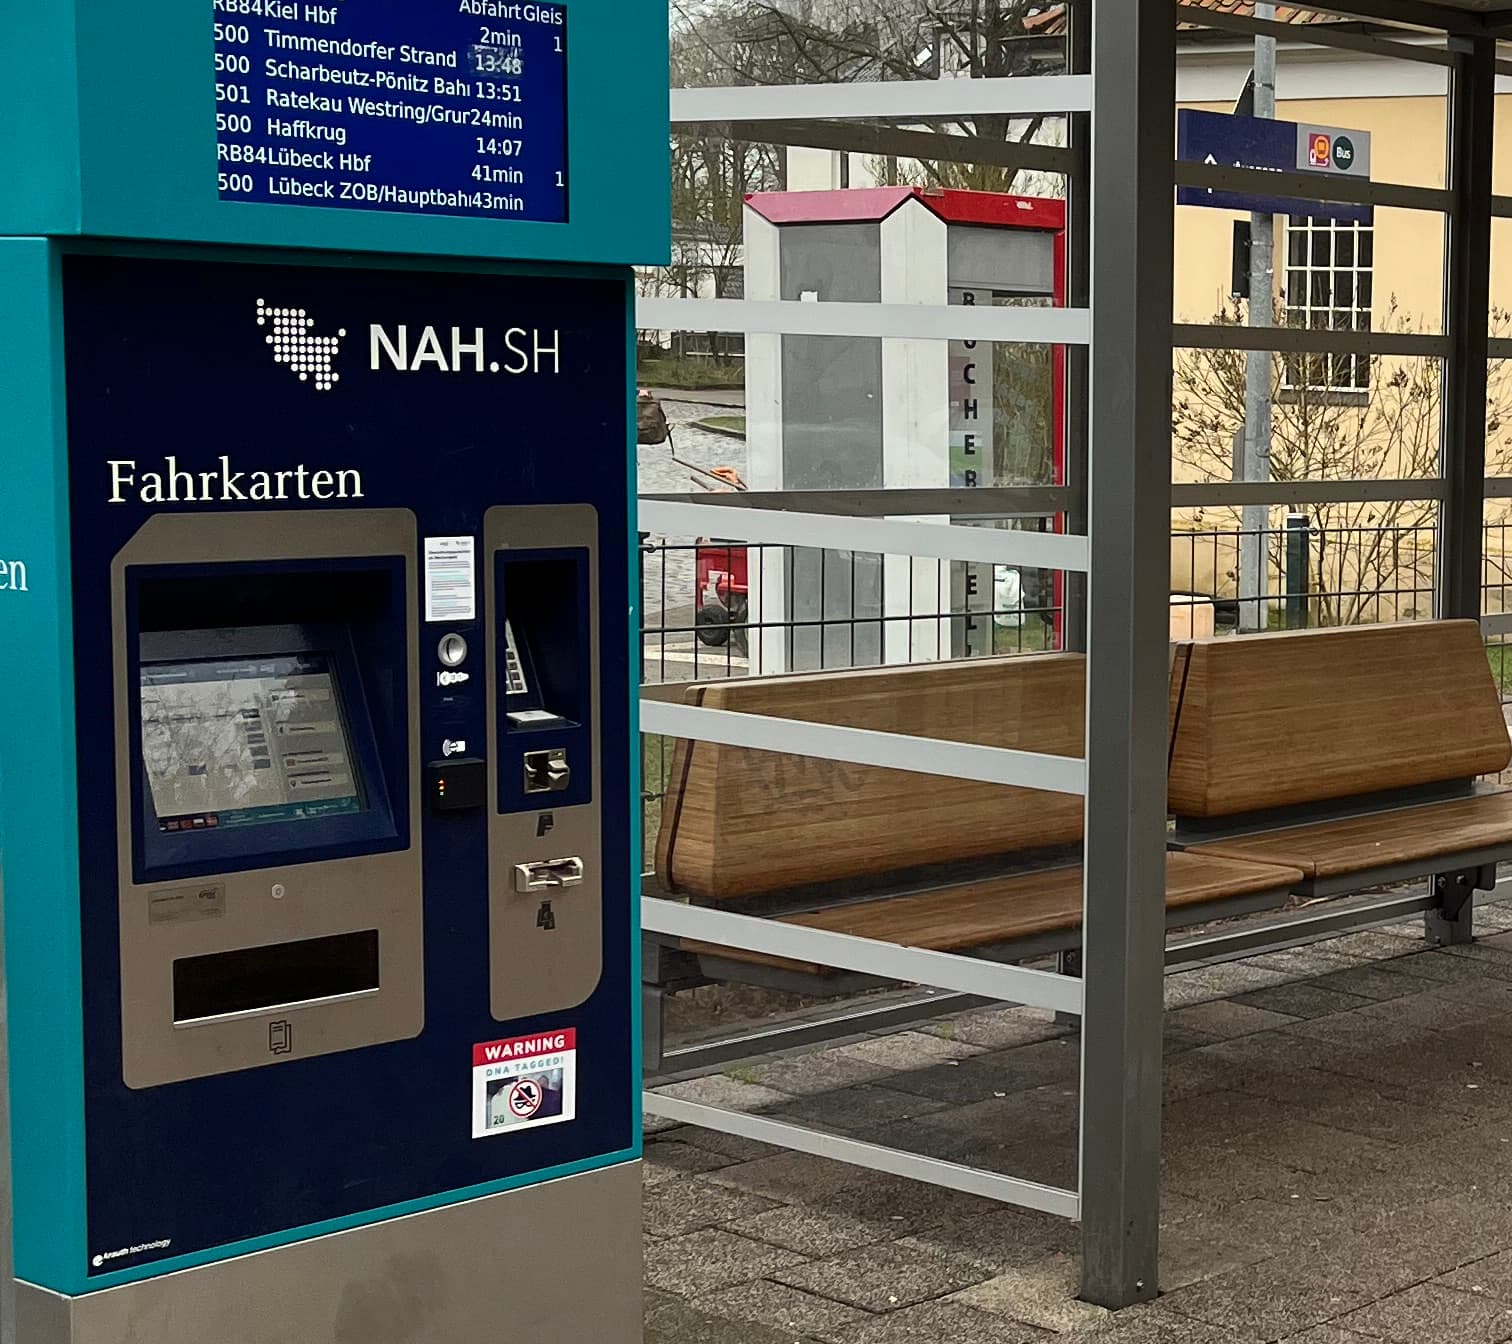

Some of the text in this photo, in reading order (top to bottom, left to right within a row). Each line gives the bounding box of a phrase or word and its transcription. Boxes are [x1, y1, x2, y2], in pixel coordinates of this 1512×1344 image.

[264, 0, 298, 20] Kiel
[304, 4, 338, 25] Hbf
[479, 26, 522, 47] 2min
[553, 36, 563, 53] 1
[523, 5, 563, 25] Gleis
[213, 23, 523, 75] 500 Timmendorfer Strand 13:48
[214, 53, 250, 74] 500
[265, 58, 428, 93] Scharbeutz-Pönitz
[475, 81, 522, 102] 13:51
[215, 83, 251, 104] 501
[266, 88, 343, 113] Ratekau
[470, 108, 523, 129] 24min
[216, 113, 523, 157] 500 Haffkrug 14:07
[1336, 146, 1351, 159] Bus
[217, 143, 564, 187] RB84 Lübeck Hbf 41min 1
[218, 173, 253, 193] 500
[269, 176, 335, 198] Lübeck
[472, 192, 524, 211] 43min
[370, 323, 560, 375] NAH.SH
[107, 456, 365, 504] Fahrkarten
[485, 1034, 565, 1061] WARNING
[486, 1056, 564, 1077] DNA TAGGED!
